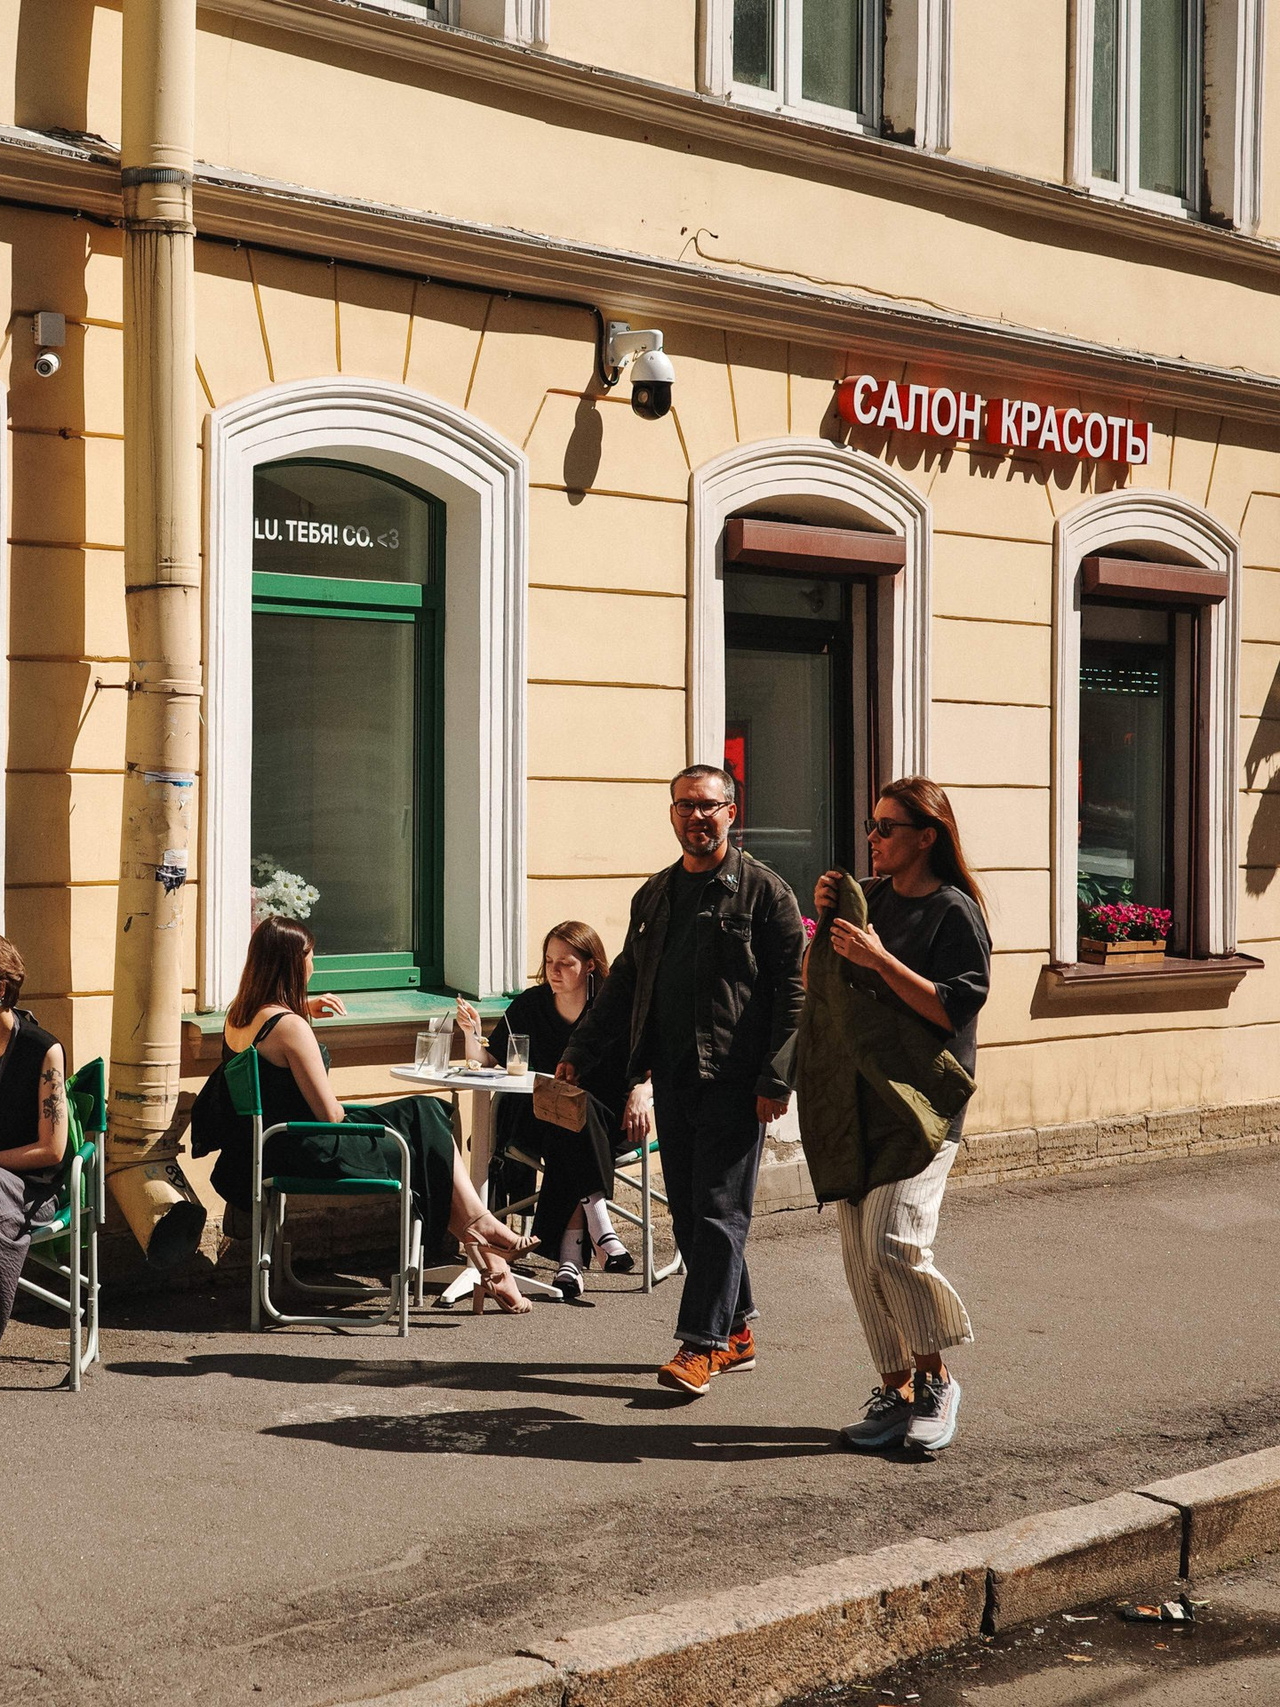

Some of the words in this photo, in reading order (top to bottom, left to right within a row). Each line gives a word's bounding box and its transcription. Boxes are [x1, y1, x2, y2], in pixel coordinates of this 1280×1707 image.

[852, 374, 982, 440] САЛОН
[1000, 399, 1154, 465] КРАСОТЫ
[254, 517, 283, 541] LU.
[285, 519, 339, 545] ТЕБЯ!
[342, 524, 374, 548] CO.
